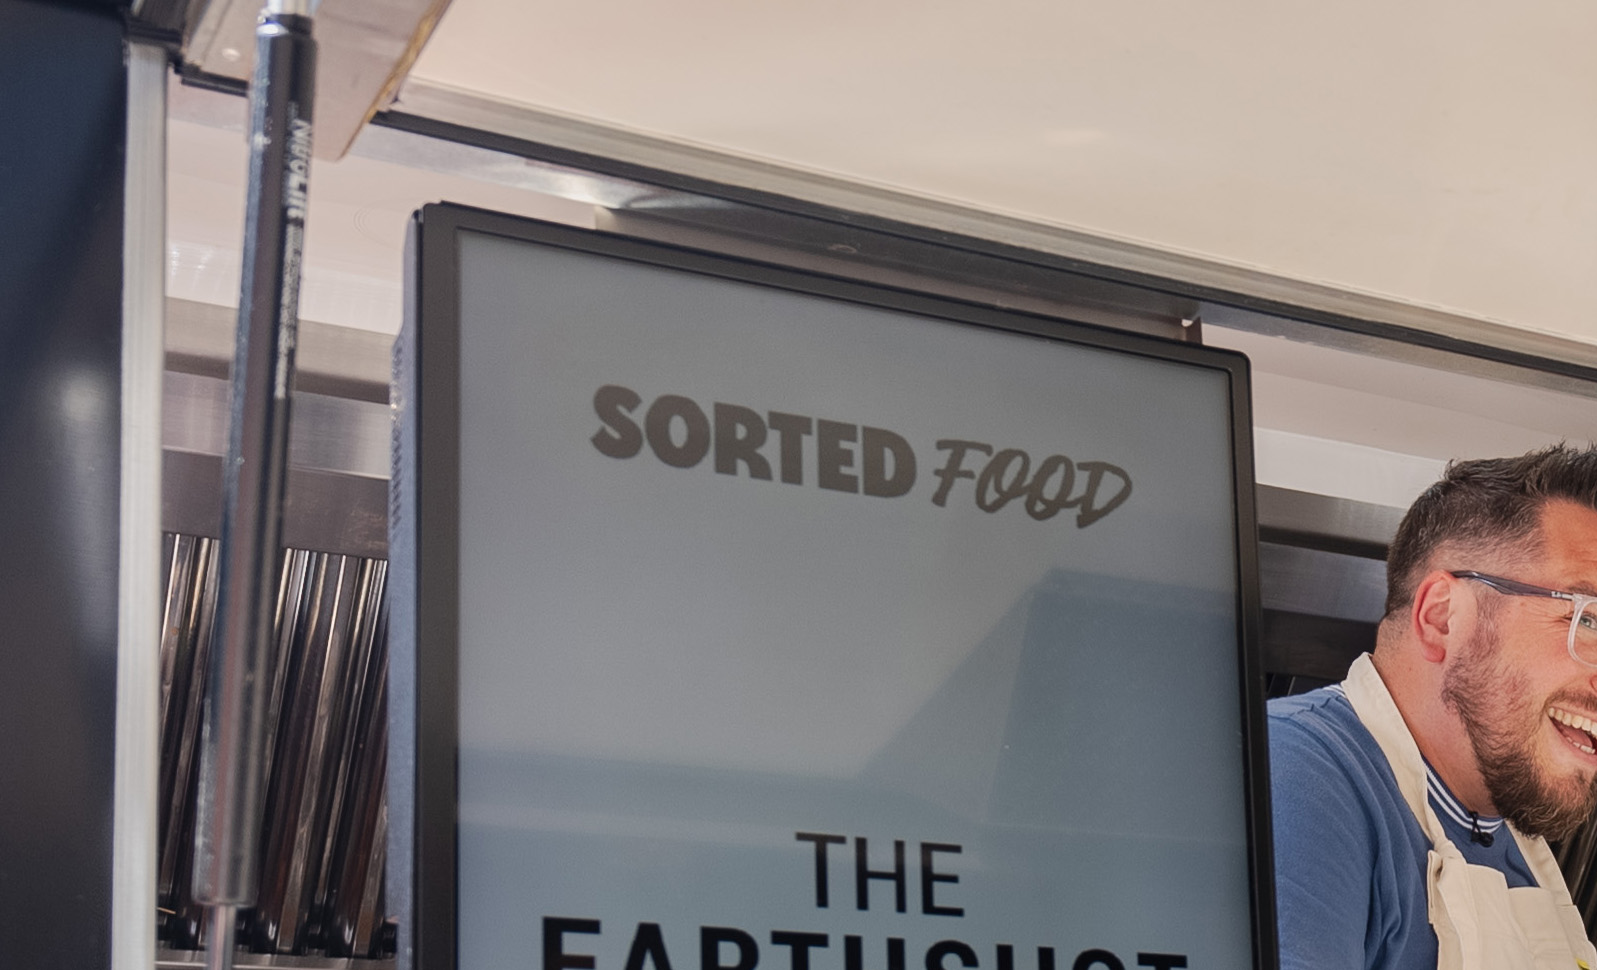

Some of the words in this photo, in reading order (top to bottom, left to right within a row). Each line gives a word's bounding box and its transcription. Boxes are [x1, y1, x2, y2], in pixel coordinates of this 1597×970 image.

[590, 384, 917, 499] SORTED
[931, 438, 1133, 530] FOOD
[795, 831, 965, 919] THE
